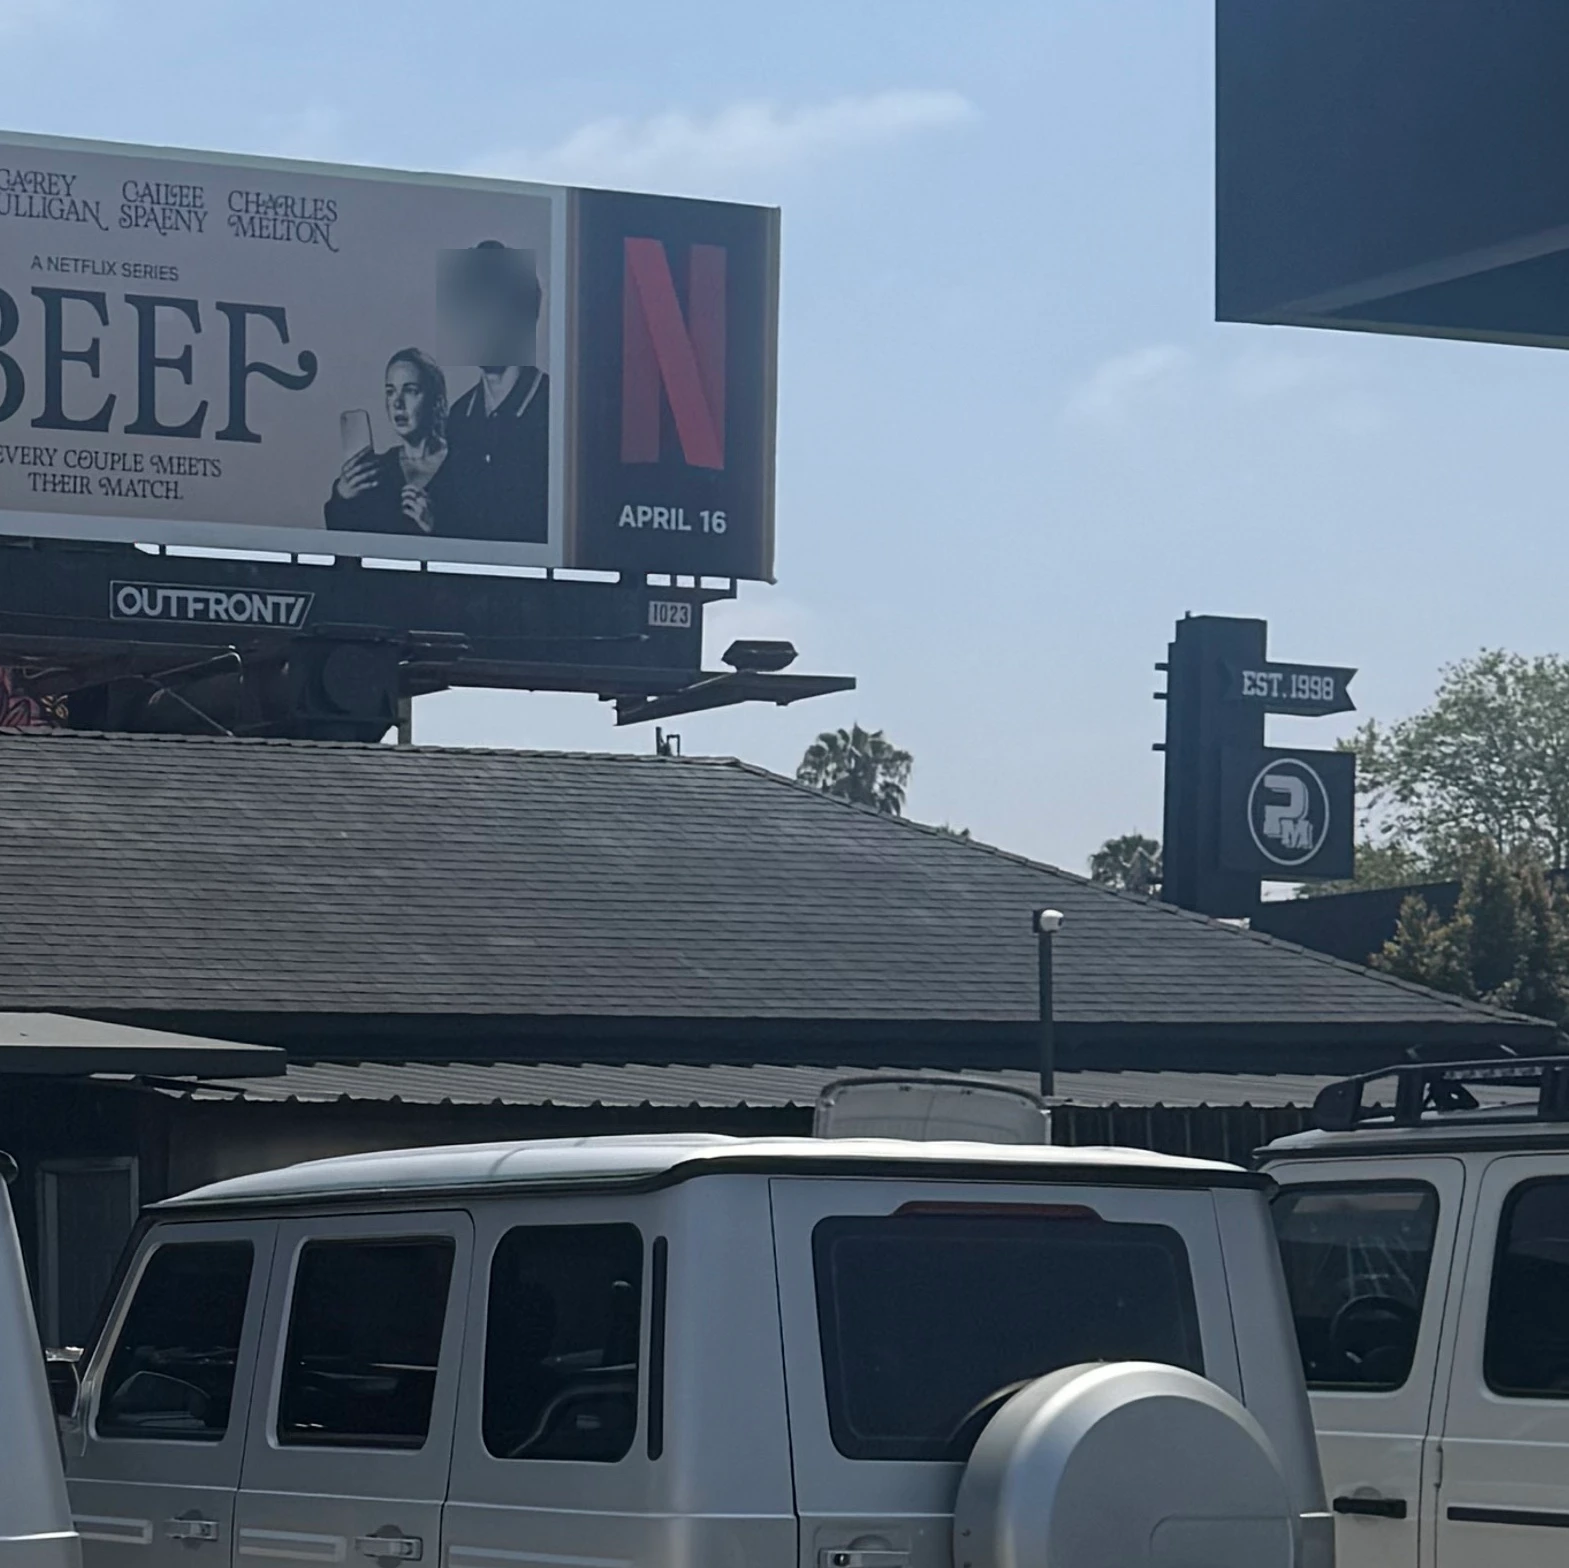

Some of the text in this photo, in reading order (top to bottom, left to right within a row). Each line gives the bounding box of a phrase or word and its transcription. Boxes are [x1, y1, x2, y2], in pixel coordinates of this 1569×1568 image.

[122, 180, 205, 209] CAILEE
[228, 190, 339, 223] CHARLES
[118, 204, 209, 236] SPAENY
[227, 214, 340, 253] MELTON
[30, 254, 180, 282] A NETFLIX SERIES
[620, 236, 728, 471] N
[63, 449, 145, 473] COUPLE
[150, 454, 223, 478] MEETS
[28, 472, 94, 496] THEIR
[618, 504, 727, 534] APRIL 16
[653, 603, 689, 624] 1023
